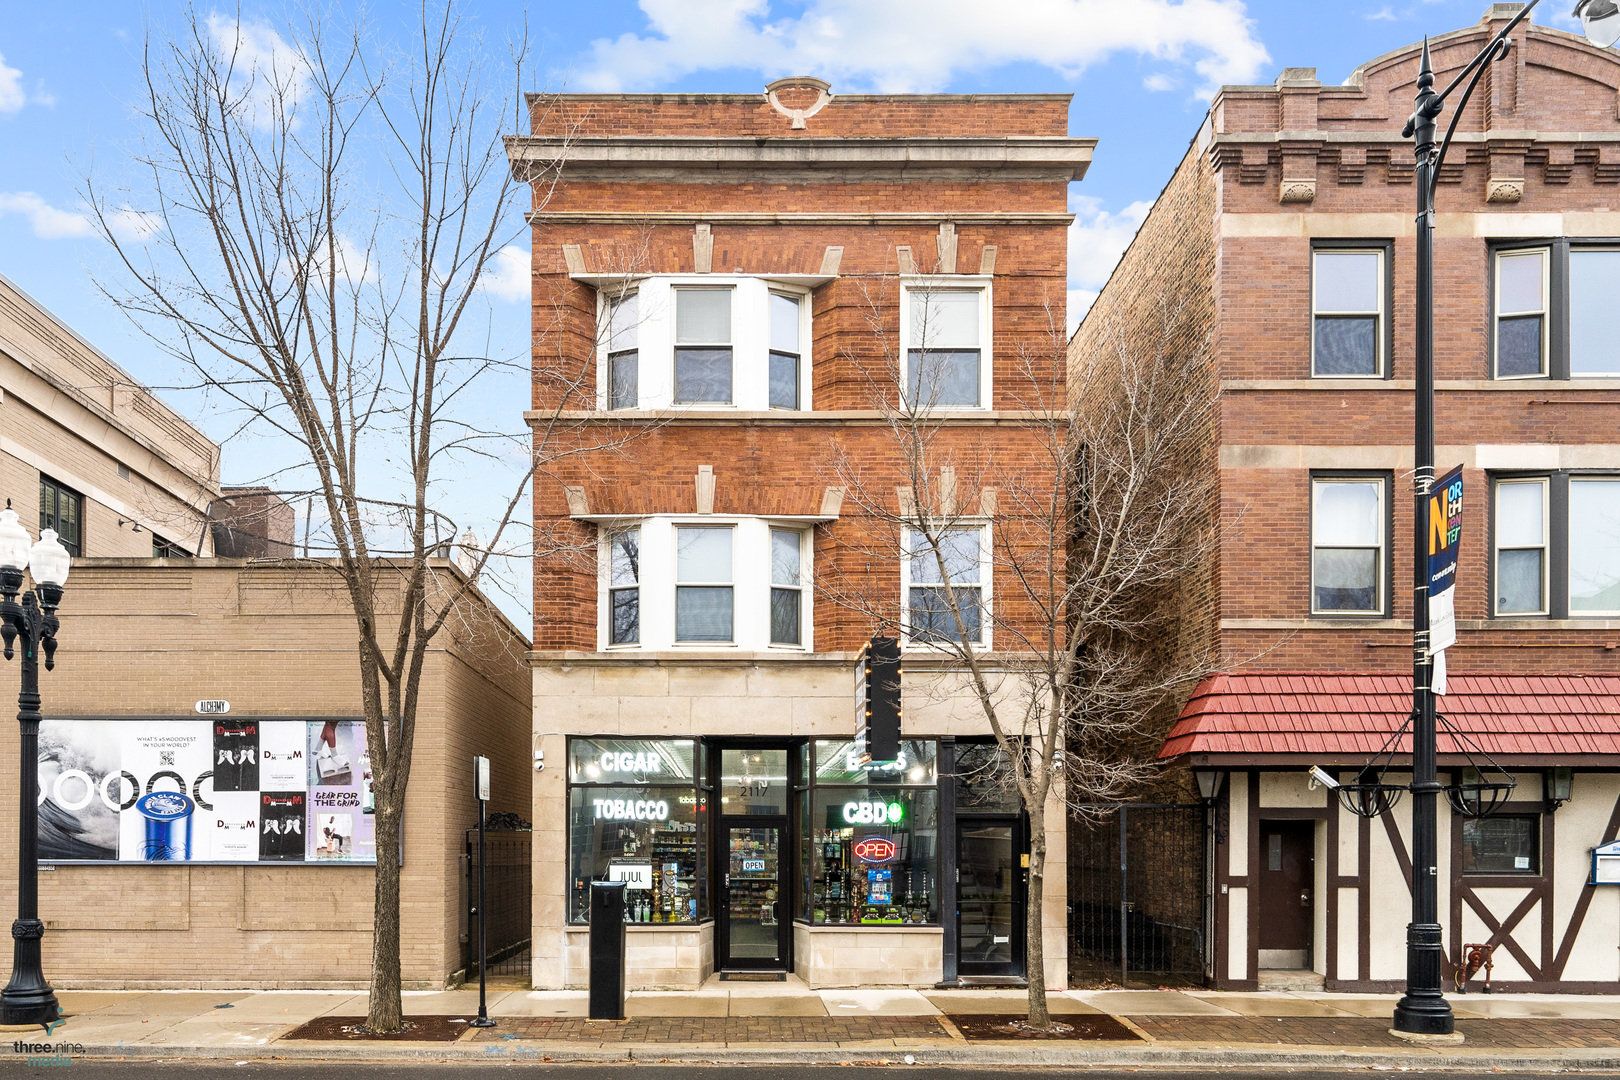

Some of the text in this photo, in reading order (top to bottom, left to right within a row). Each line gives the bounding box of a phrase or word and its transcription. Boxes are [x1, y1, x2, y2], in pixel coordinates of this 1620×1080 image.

[600, 752, 661, 772] CIGAR
[315, 791, 358, 800] GEAR FOR
[740, 786, 768, 796] 2117
[337, 799, 360, 807] GRIND
[593, 799, 668, 820] TOBACCO
[843, 802, 888, 824] CBD
[854, 843, 896, 858] OPEN
[745, 861, 763, 869] OPEN
[620, 871, 642, 883] JUUL
